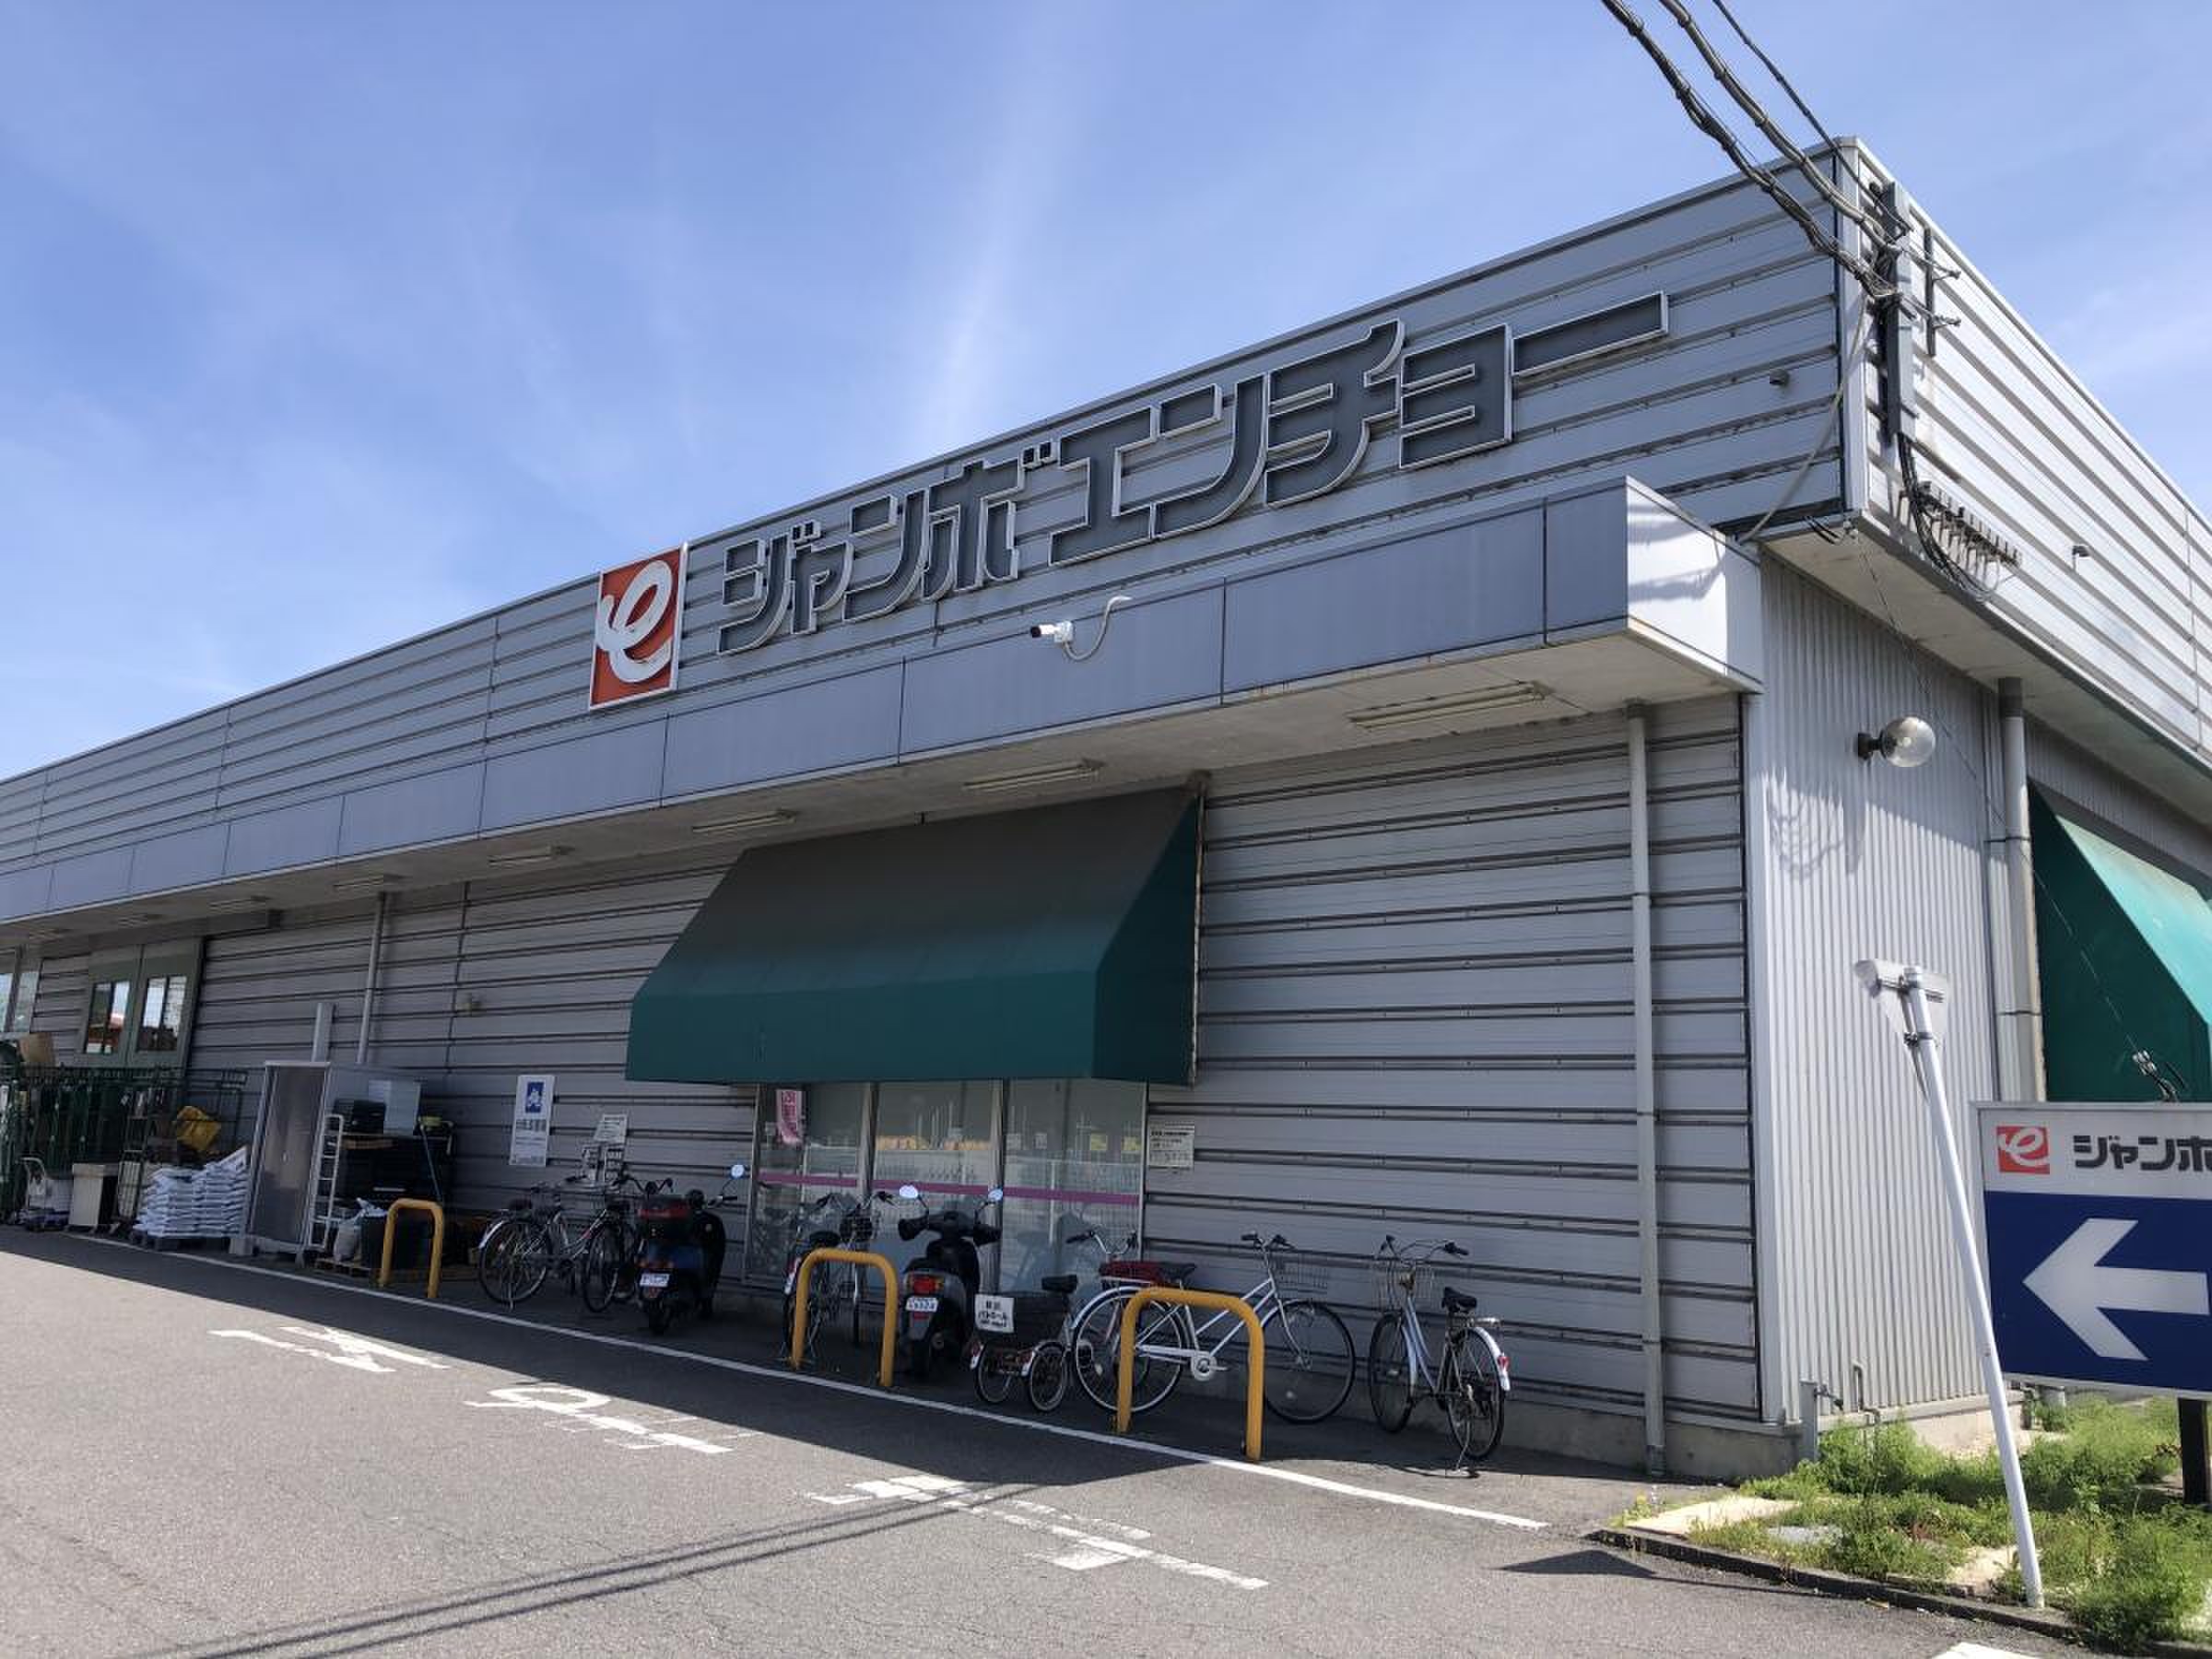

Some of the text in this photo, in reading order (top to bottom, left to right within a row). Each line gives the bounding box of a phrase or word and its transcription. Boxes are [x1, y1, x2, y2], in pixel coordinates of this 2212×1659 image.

[716, 289, 1669, 656] ジャンボエンチョー
